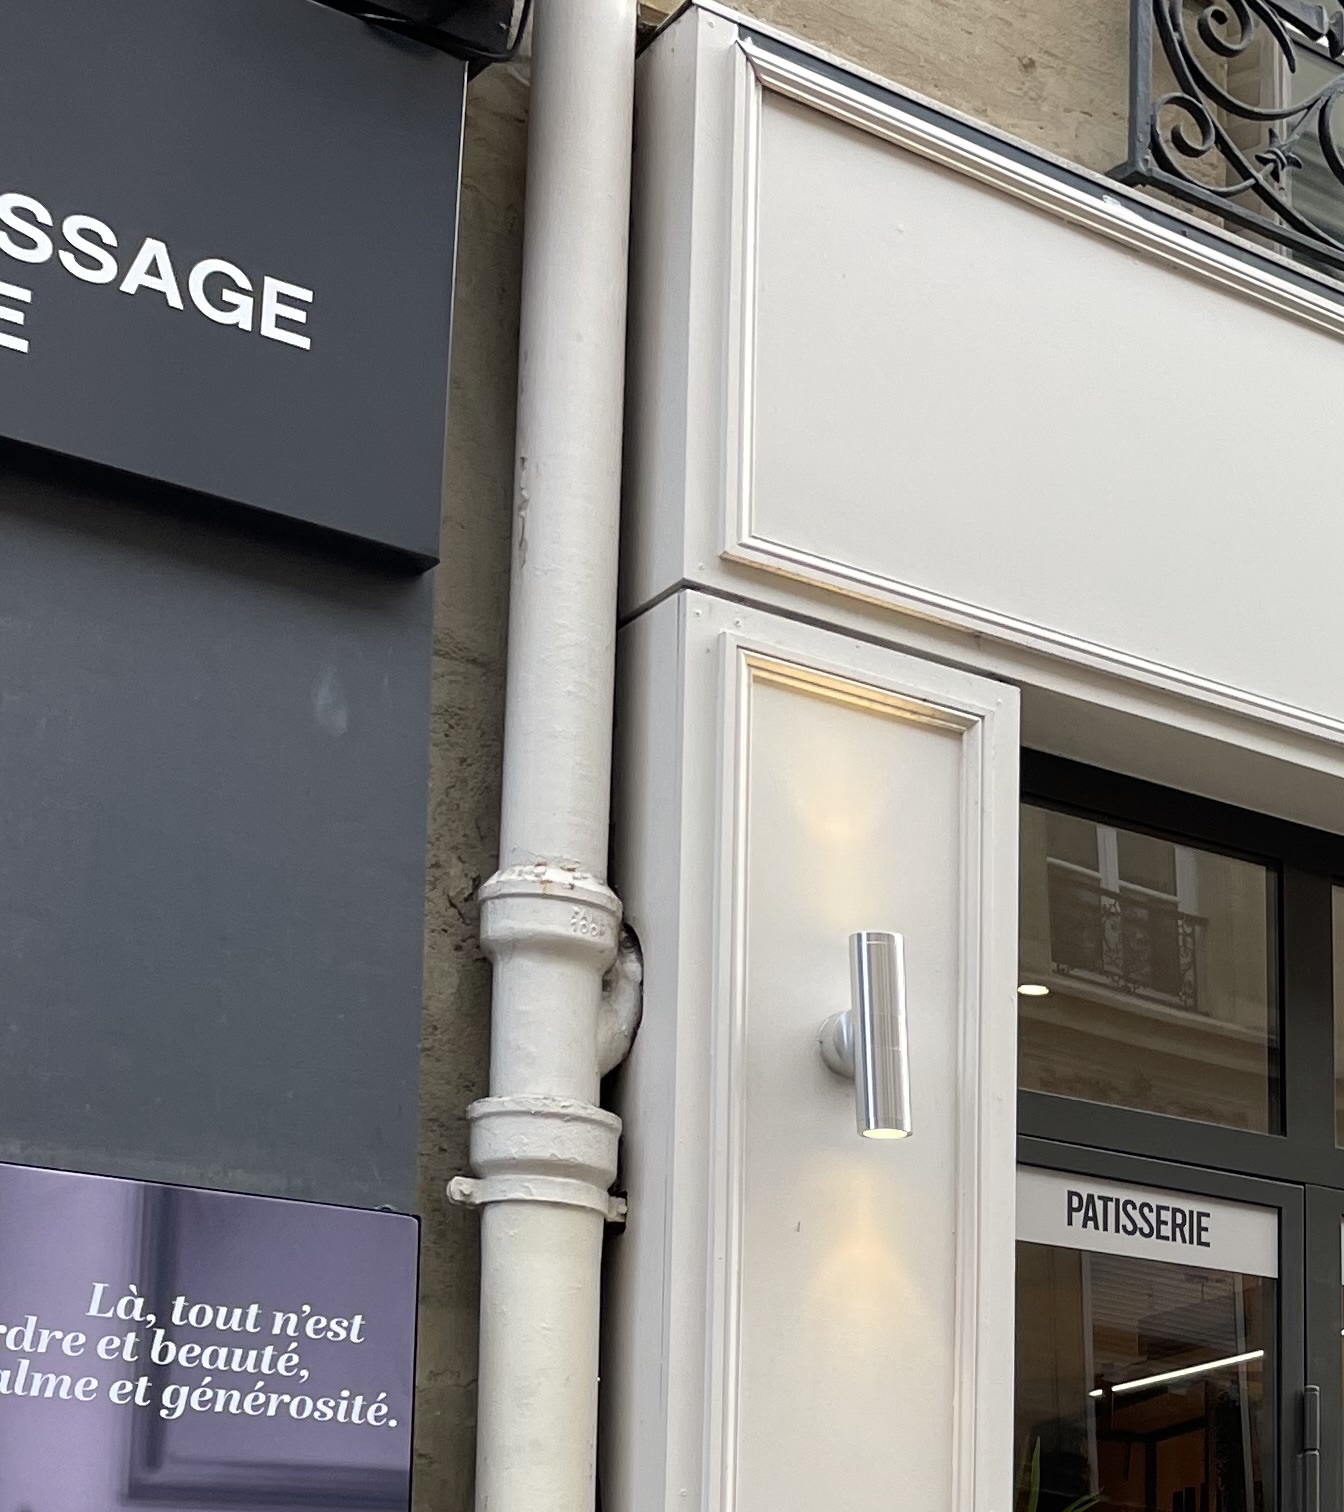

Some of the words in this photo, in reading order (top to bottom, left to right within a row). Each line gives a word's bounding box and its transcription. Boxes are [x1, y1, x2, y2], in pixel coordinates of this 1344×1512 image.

[0, 192, 314, 351] SSAGE
[1065, 1189, 1211, 1249] PATISSERIE
[85, 1282, 157, 1326] Là,
[171, 1296, 263, 1333] tout
[271, 1304, 366, 1344] n'est
[0, 1314, 86, 1357] dre
[96, 1332, 140, 1363] et
[150, 1328, 310, 1384] beauté,
[108, 1376, 153, 1407] et
[159, 1377, 399, 1428] générosité.
